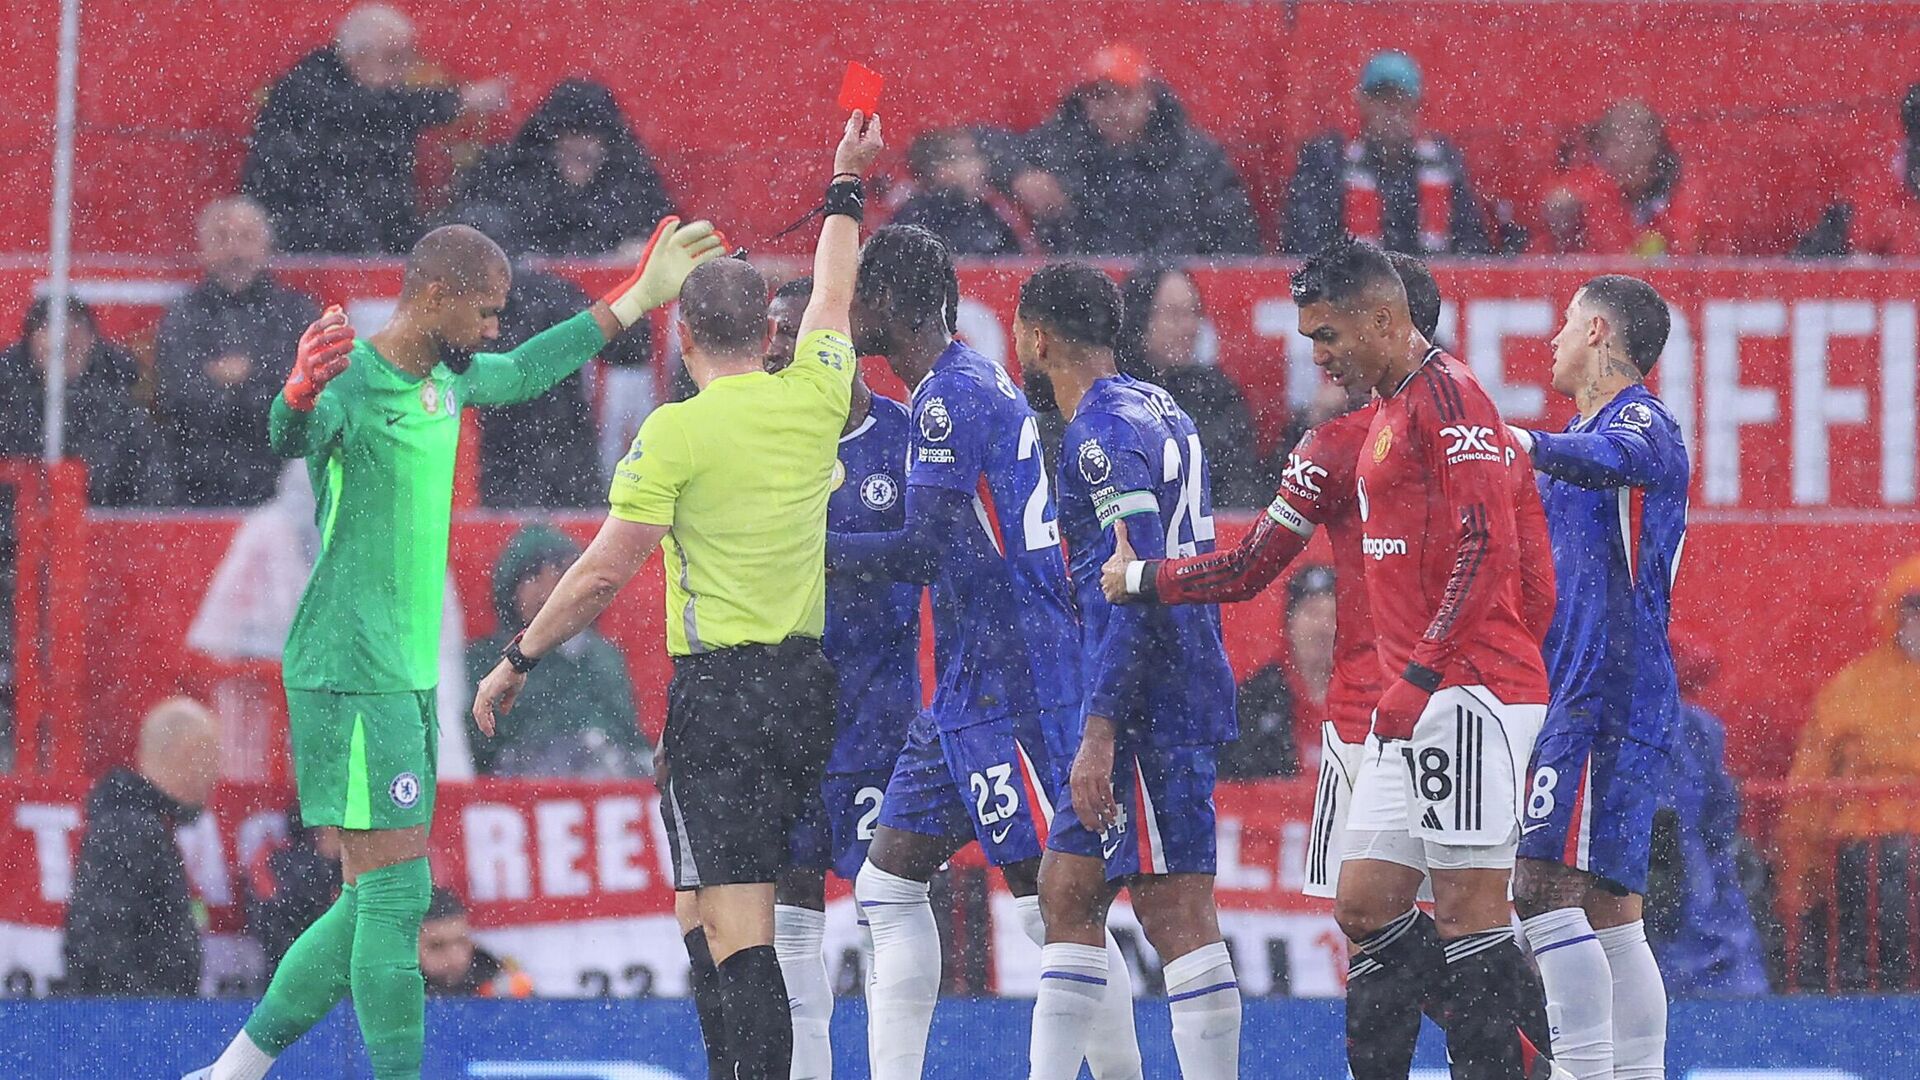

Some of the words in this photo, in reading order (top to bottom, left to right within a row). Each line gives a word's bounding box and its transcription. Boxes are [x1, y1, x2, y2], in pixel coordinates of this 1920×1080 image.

[1439, 424, 1500, 455] DXC
[1447, 452, 1501, 466] TECHNOLOGY
[970, 762, 1019, 826] 23
[1401, 746, 1452, 802] 18
[1527, 766, 1558, 819] 8
